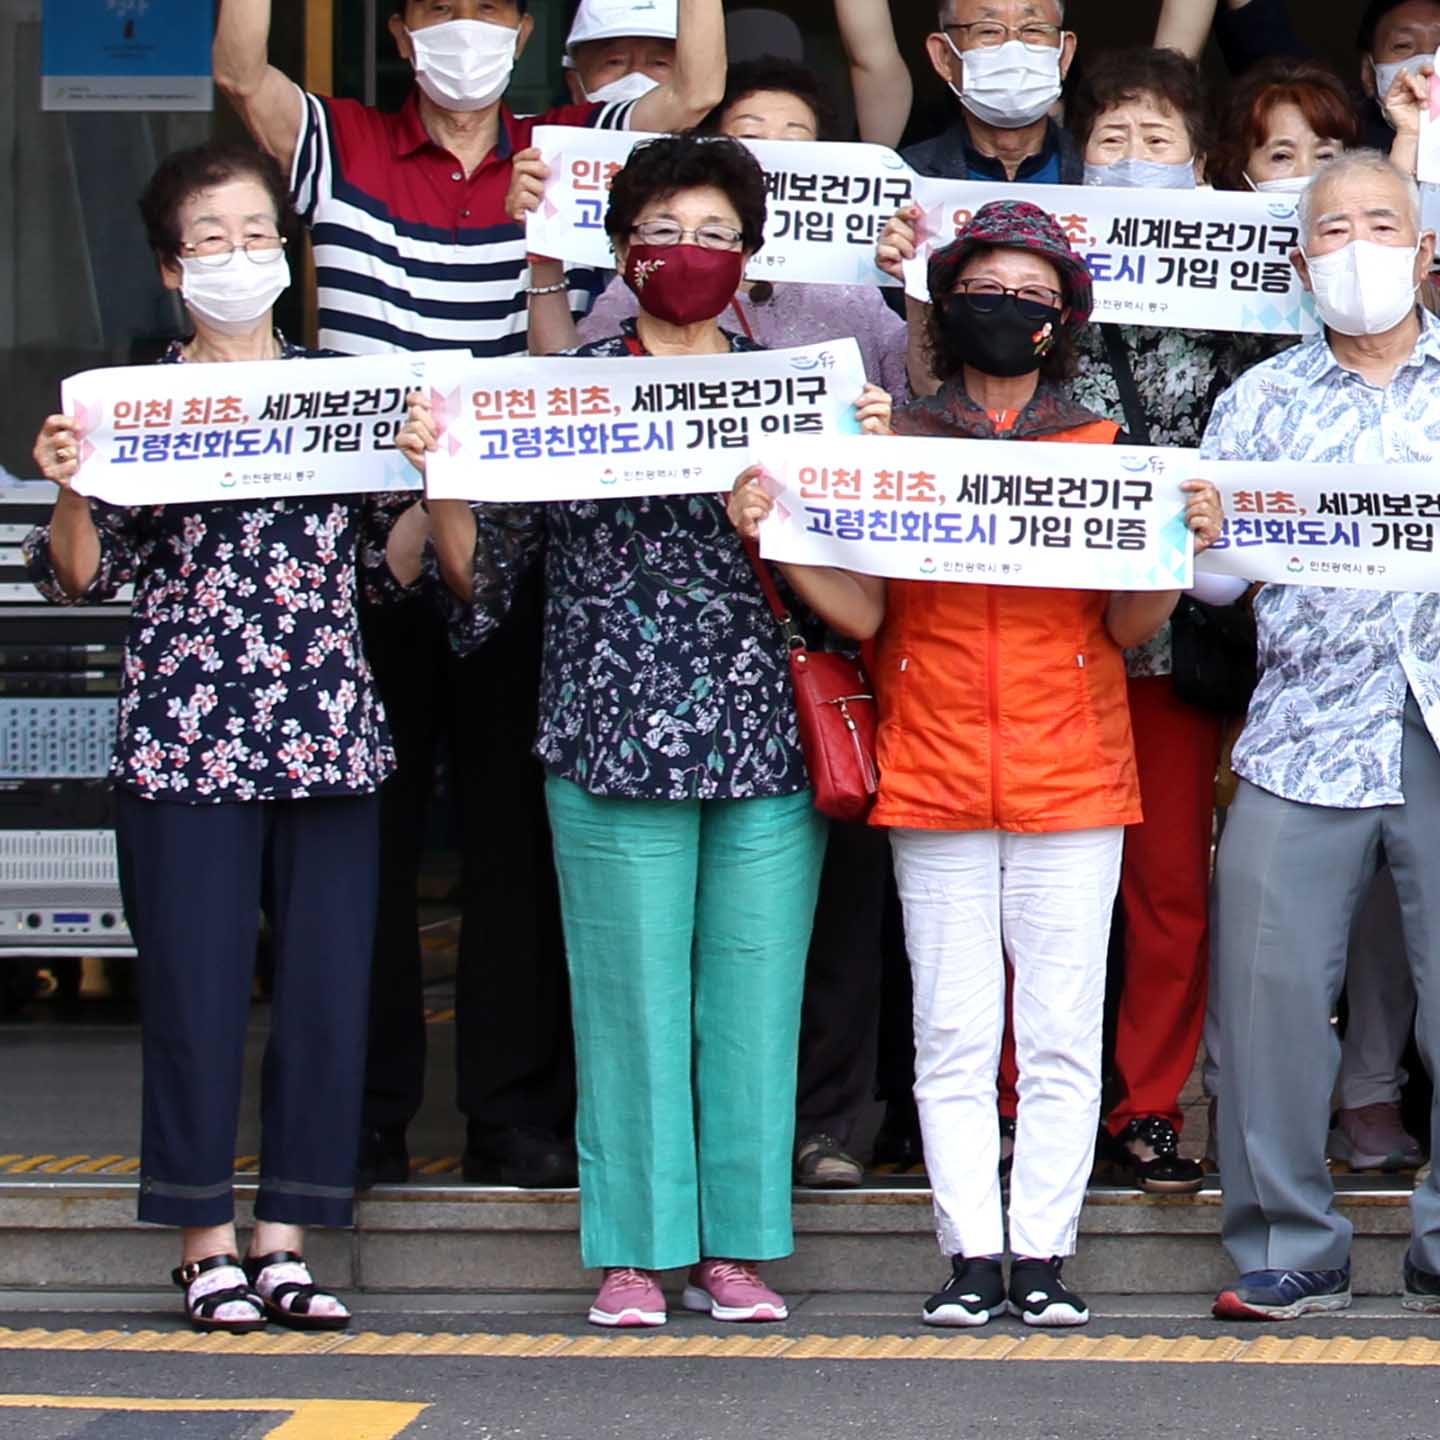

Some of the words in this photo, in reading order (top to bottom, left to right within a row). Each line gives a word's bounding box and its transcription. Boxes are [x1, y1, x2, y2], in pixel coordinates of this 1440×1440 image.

[472, 389, 536, 420] 인천
[547, 385, 621, 416] 최초,
[631, 376, 827, 412] 세계보건기구
[480, 420, 673, 459] 고령친화도시
[686, 416, 748, 449] 가입
[799, 467, 861, 500] 인천
[873, 470, 945, 505] 최초,
[957, 474, 1153, 510] 세계보건기구
[804, 506, 996, 544] 고령친화도시
[1008, 515, 1071, 548] 가입
[1084, 518, 1146, 550] 인증
